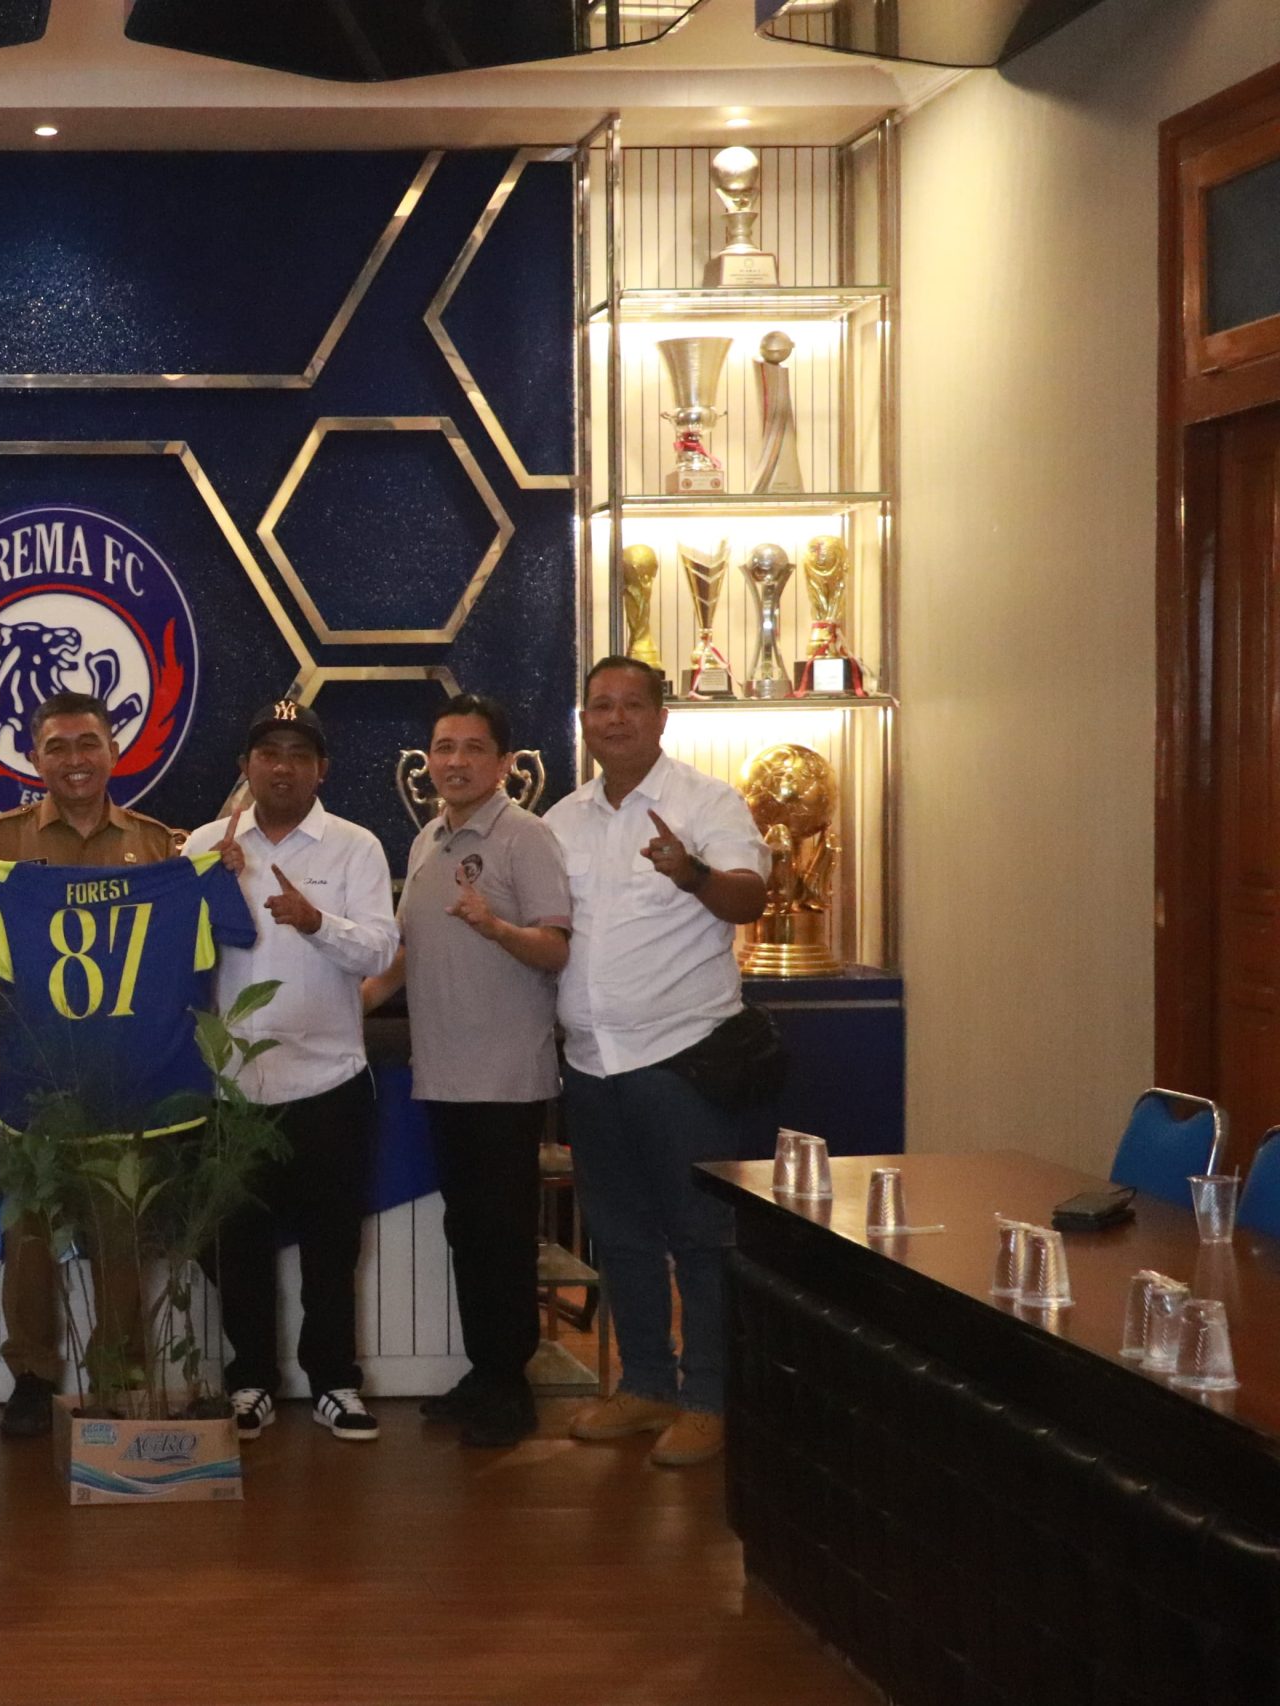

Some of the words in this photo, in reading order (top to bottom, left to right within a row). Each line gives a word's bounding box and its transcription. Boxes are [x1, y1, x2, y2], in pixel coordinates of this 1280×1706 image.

[103, 534, 144, 596] FC
[66, 879, 130, 905] FOREST
[49, 903, 153, 1019] 87
